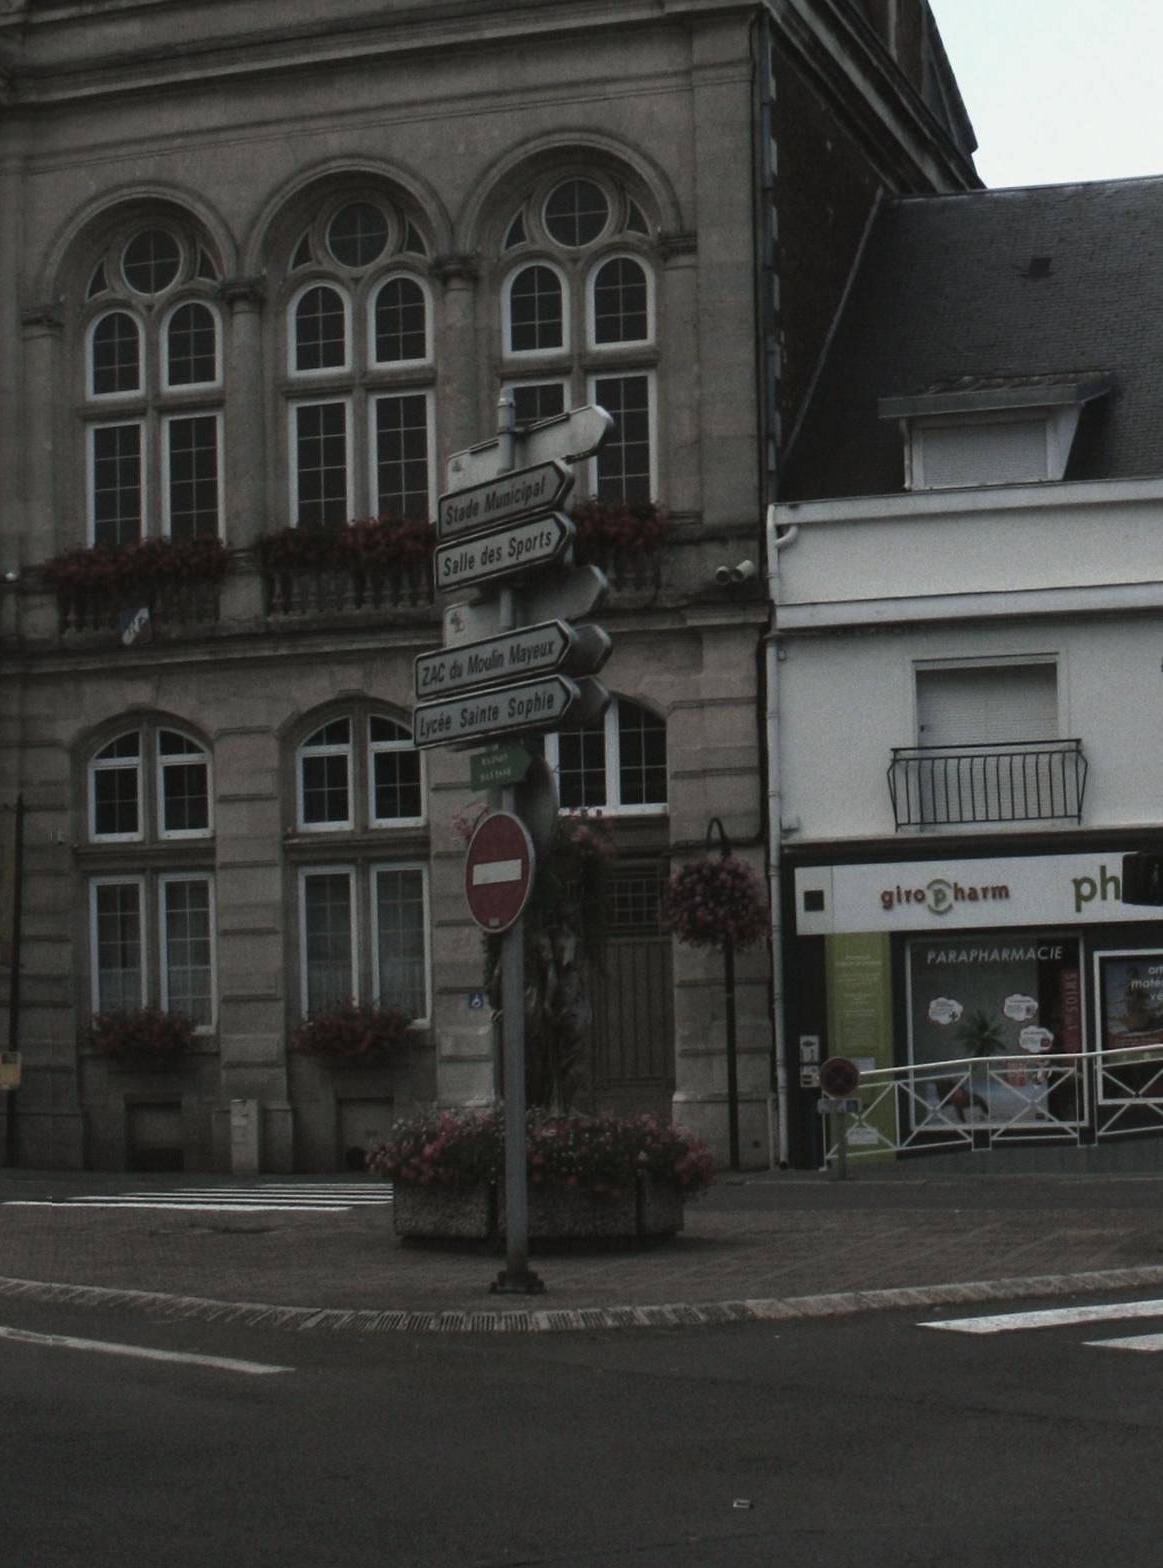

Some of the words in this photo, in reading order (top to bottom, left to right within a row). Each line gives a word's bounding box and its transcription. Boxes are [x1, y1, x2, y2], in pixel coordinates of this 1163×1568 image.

[445, 498, 479, 526] Stade
[485, 475, 545, 512] Municipal
[443, 552, 475, 577] Salle
[480, 545, 502, 567] des
[508, 531, 552, 561] Sports
[421, 662, 446, 688] ZAC
[449, 659, 463, 680] du
[467, 649, 505, 676] Moulin
[508, 639, 555, 666] Mayeux
[420, 712, 452, 739] Lycée
[460, 705, 500, 729] Sainte
[508, 691, 554, 720] Sophie
[926, 945, 1064, 965] PARAPHARMACIE
